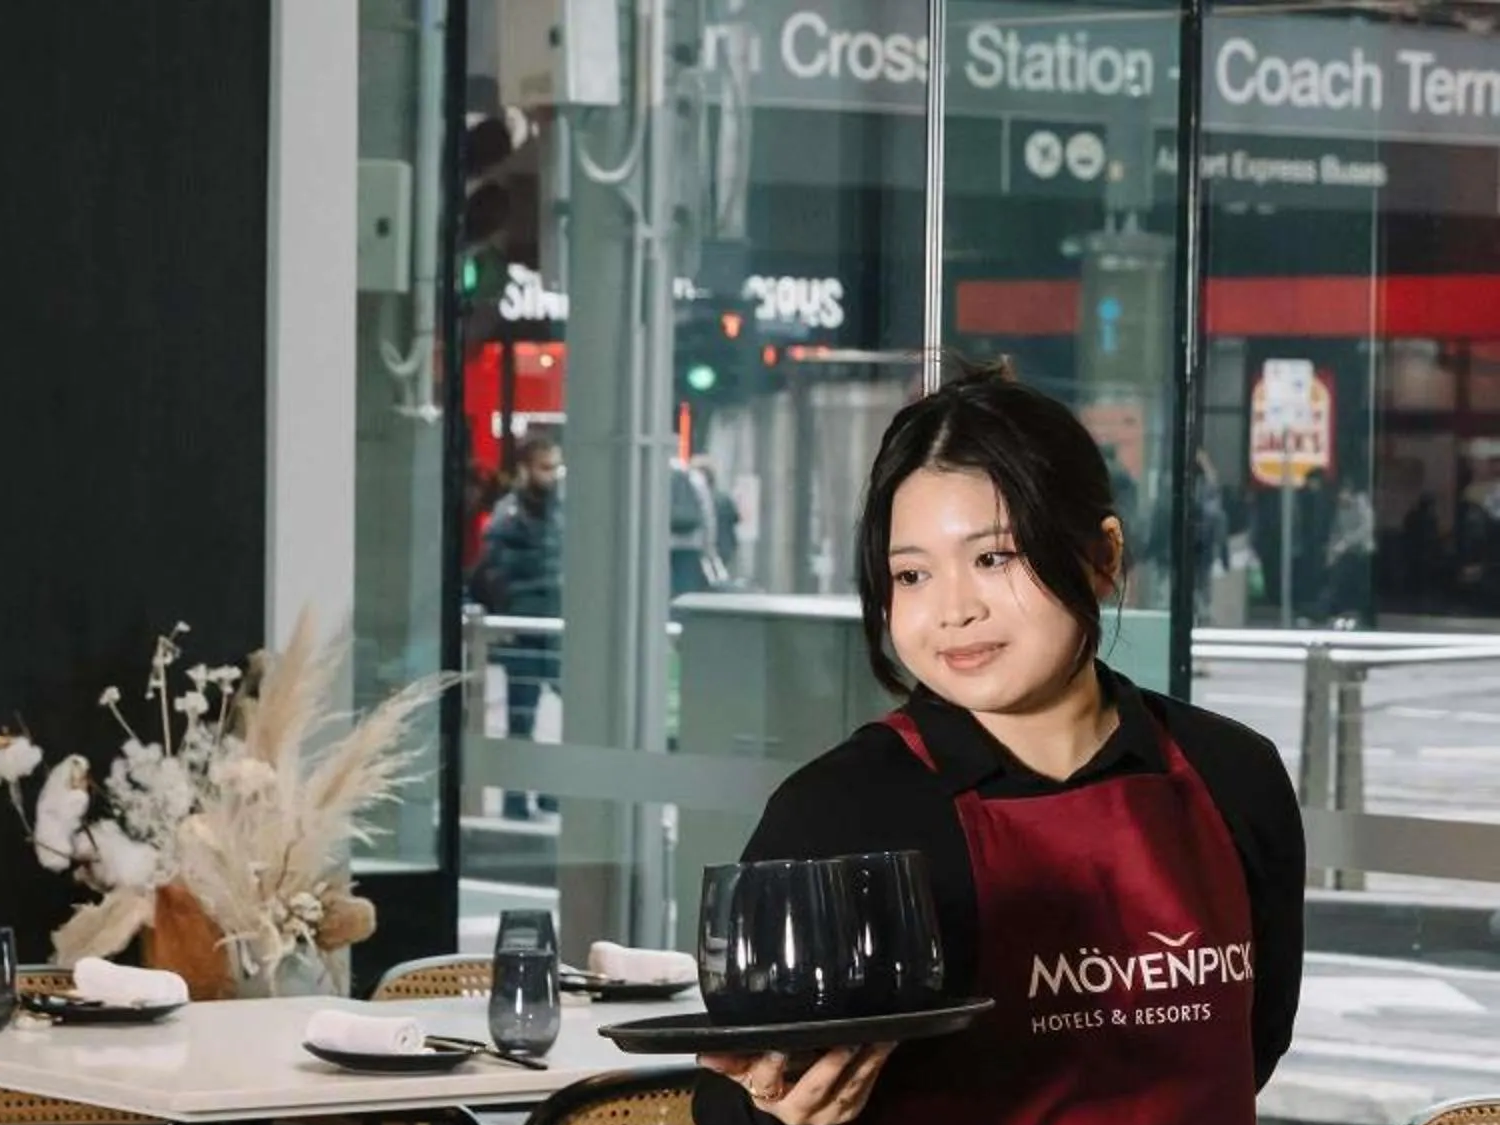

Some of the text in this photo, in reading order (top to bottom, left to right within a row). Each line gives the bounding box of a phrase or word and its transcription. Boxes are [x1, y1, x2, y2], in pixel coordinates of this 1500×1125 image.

[964, 22, 1154, 96] Station
[1215, 37, 1383, 112] Coach
[1028, 941, 1253, 998] MÖVENPICK
[1031, 1003, 1211, 1034] HOTELS & RESORTS
